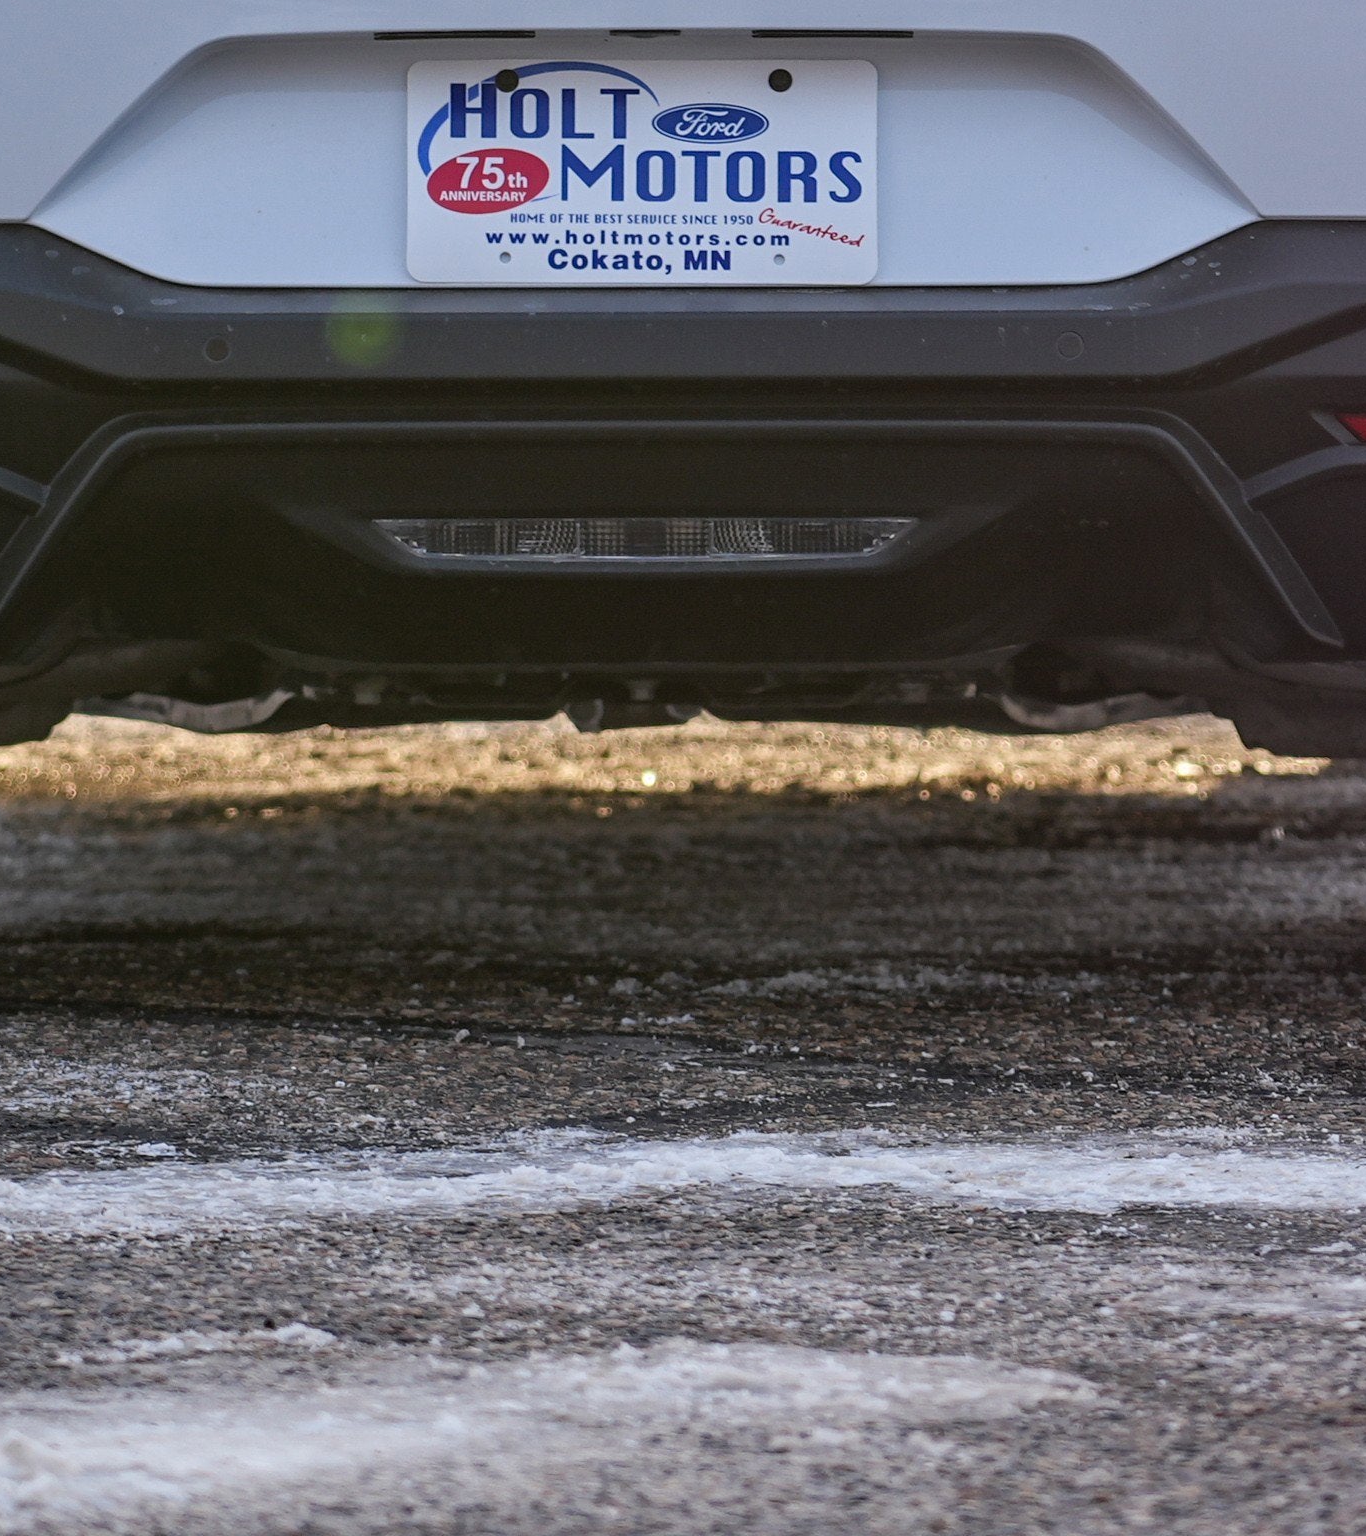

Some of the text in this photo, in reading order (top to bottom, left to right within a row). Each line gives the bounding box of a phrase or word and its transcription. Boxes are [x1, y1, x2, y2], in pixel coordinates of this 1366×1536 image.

[450, 82, 641, 139] HOLT
[674, 108, 746, 138] Ford
[455, 156, 529, 190] 75th
[561, 144, 863, 203] MOTORS
[439, 190, 528, 202] ANNIVERSARY
[510, 213, 754, 225] HOME OF THE BEST SERVICE SINCE 1950
[758, 207, 865, 248] Guaranteed
[485, 230, 790, 246] www.holtmotors.com
[547, 248, 732, 275] Cokato, MN
